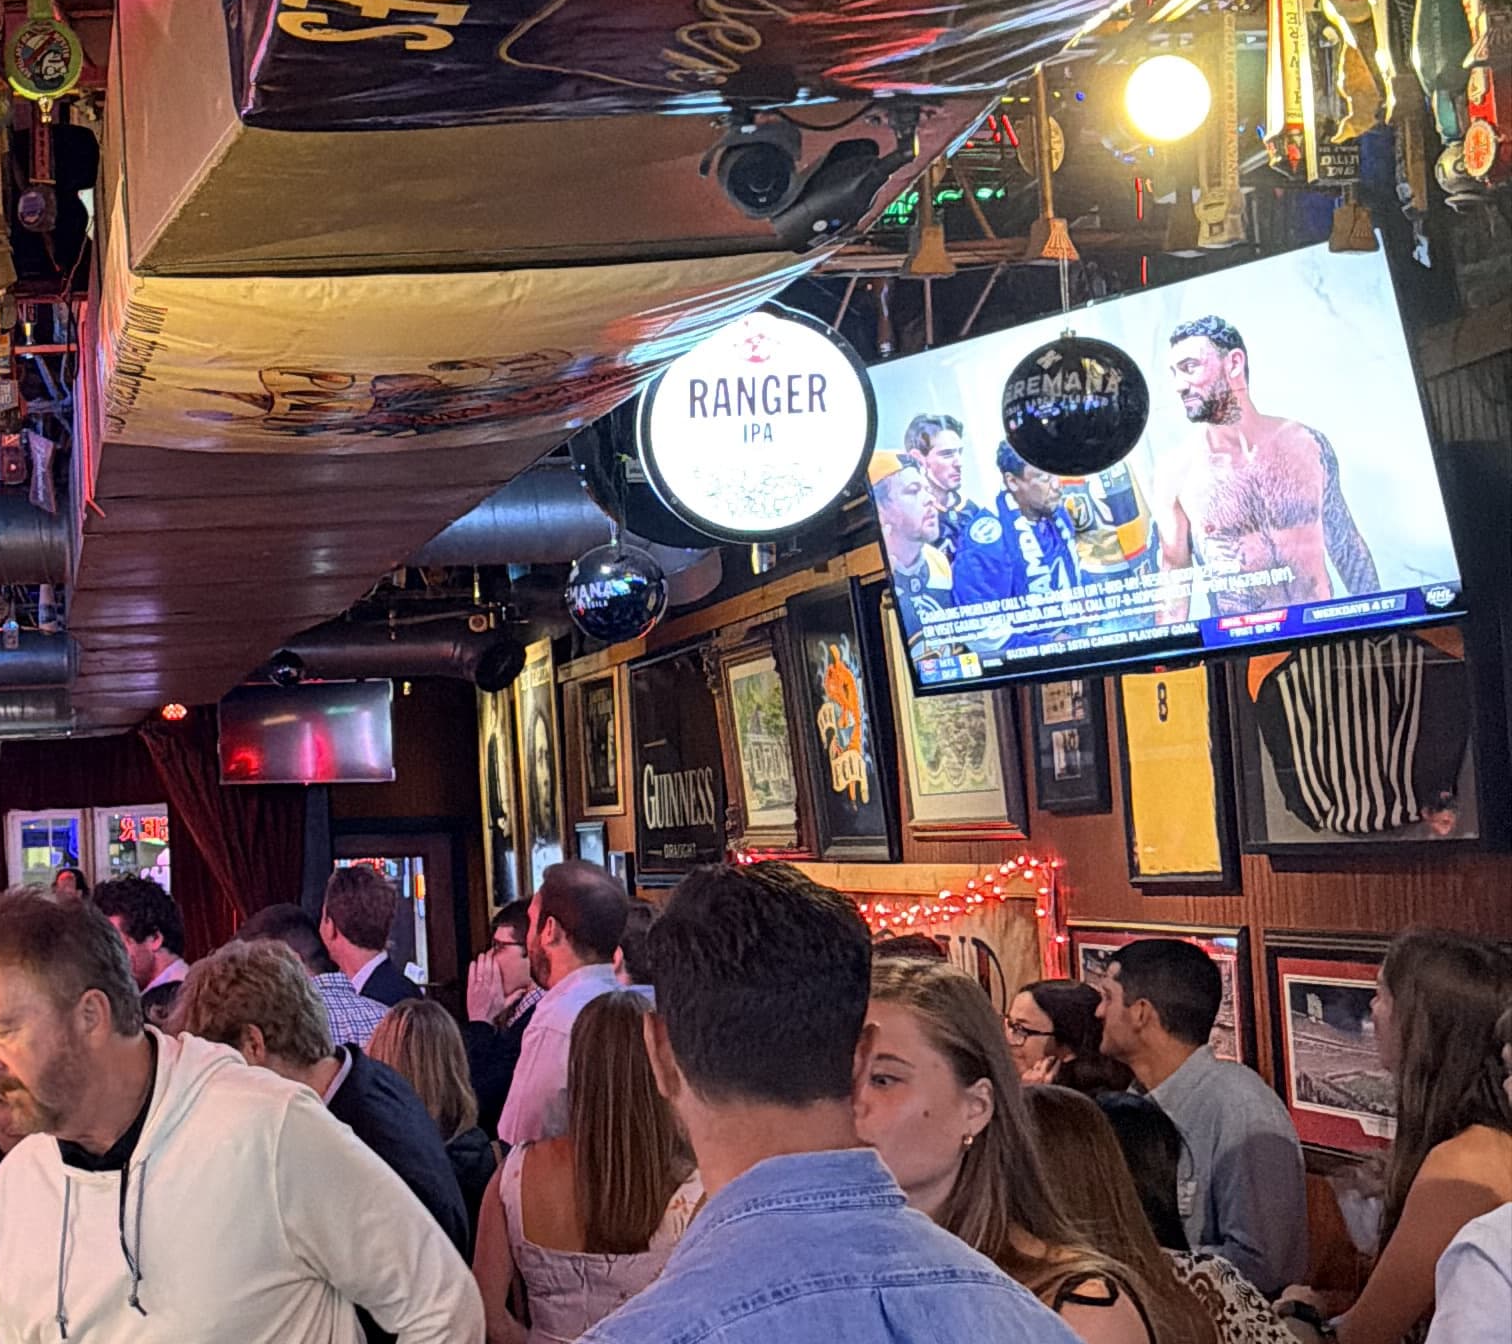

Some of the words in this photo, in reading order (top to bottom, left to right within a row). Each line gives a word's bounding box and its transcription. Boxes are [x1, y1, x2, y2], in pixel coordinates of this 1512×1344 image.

[688, 373, 827, 419] RANGER
[1004, 369, 1122, 406] EREMANA
[743, 423, 774, 444] IPA
[1170, 622, 1198, 636] GOAL
[643, 762, 717, 832] GUINNESS
